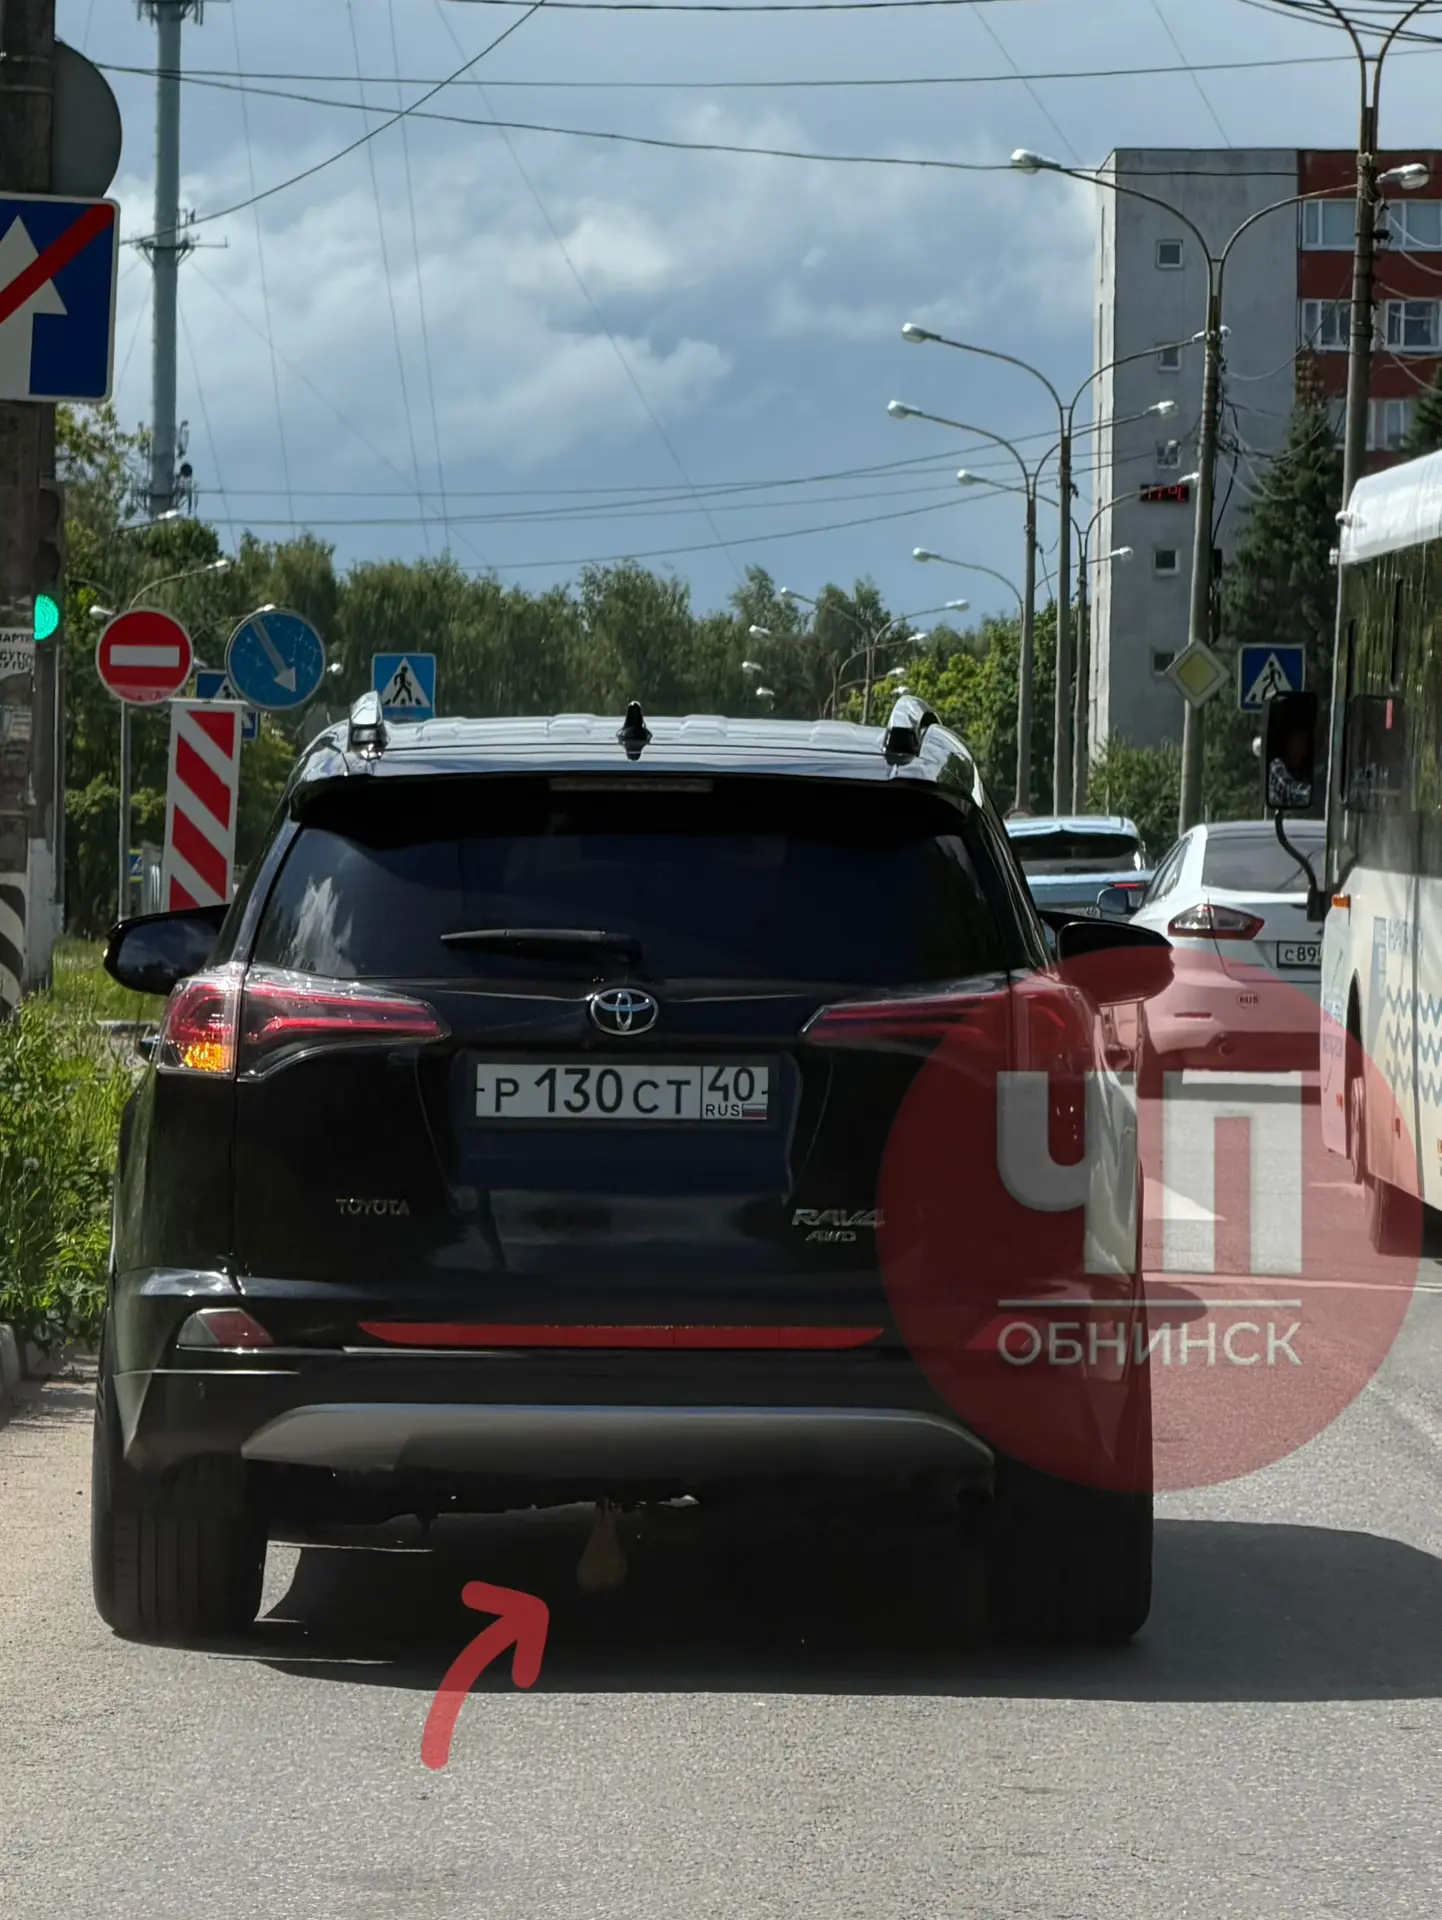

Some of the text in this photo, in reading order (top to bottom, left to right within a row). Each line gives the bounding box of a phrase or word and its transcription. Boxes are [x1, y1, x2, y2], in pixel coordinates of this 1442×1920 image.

[707, 1066, 756, 1102] 40
[704, 1103, 740, 1117] RUS
[335, 1198, 410, 1216] TOYOTA
[791, 1208, 885, 1228] RAV4
[804, 1230, 857, 1242] AWD
